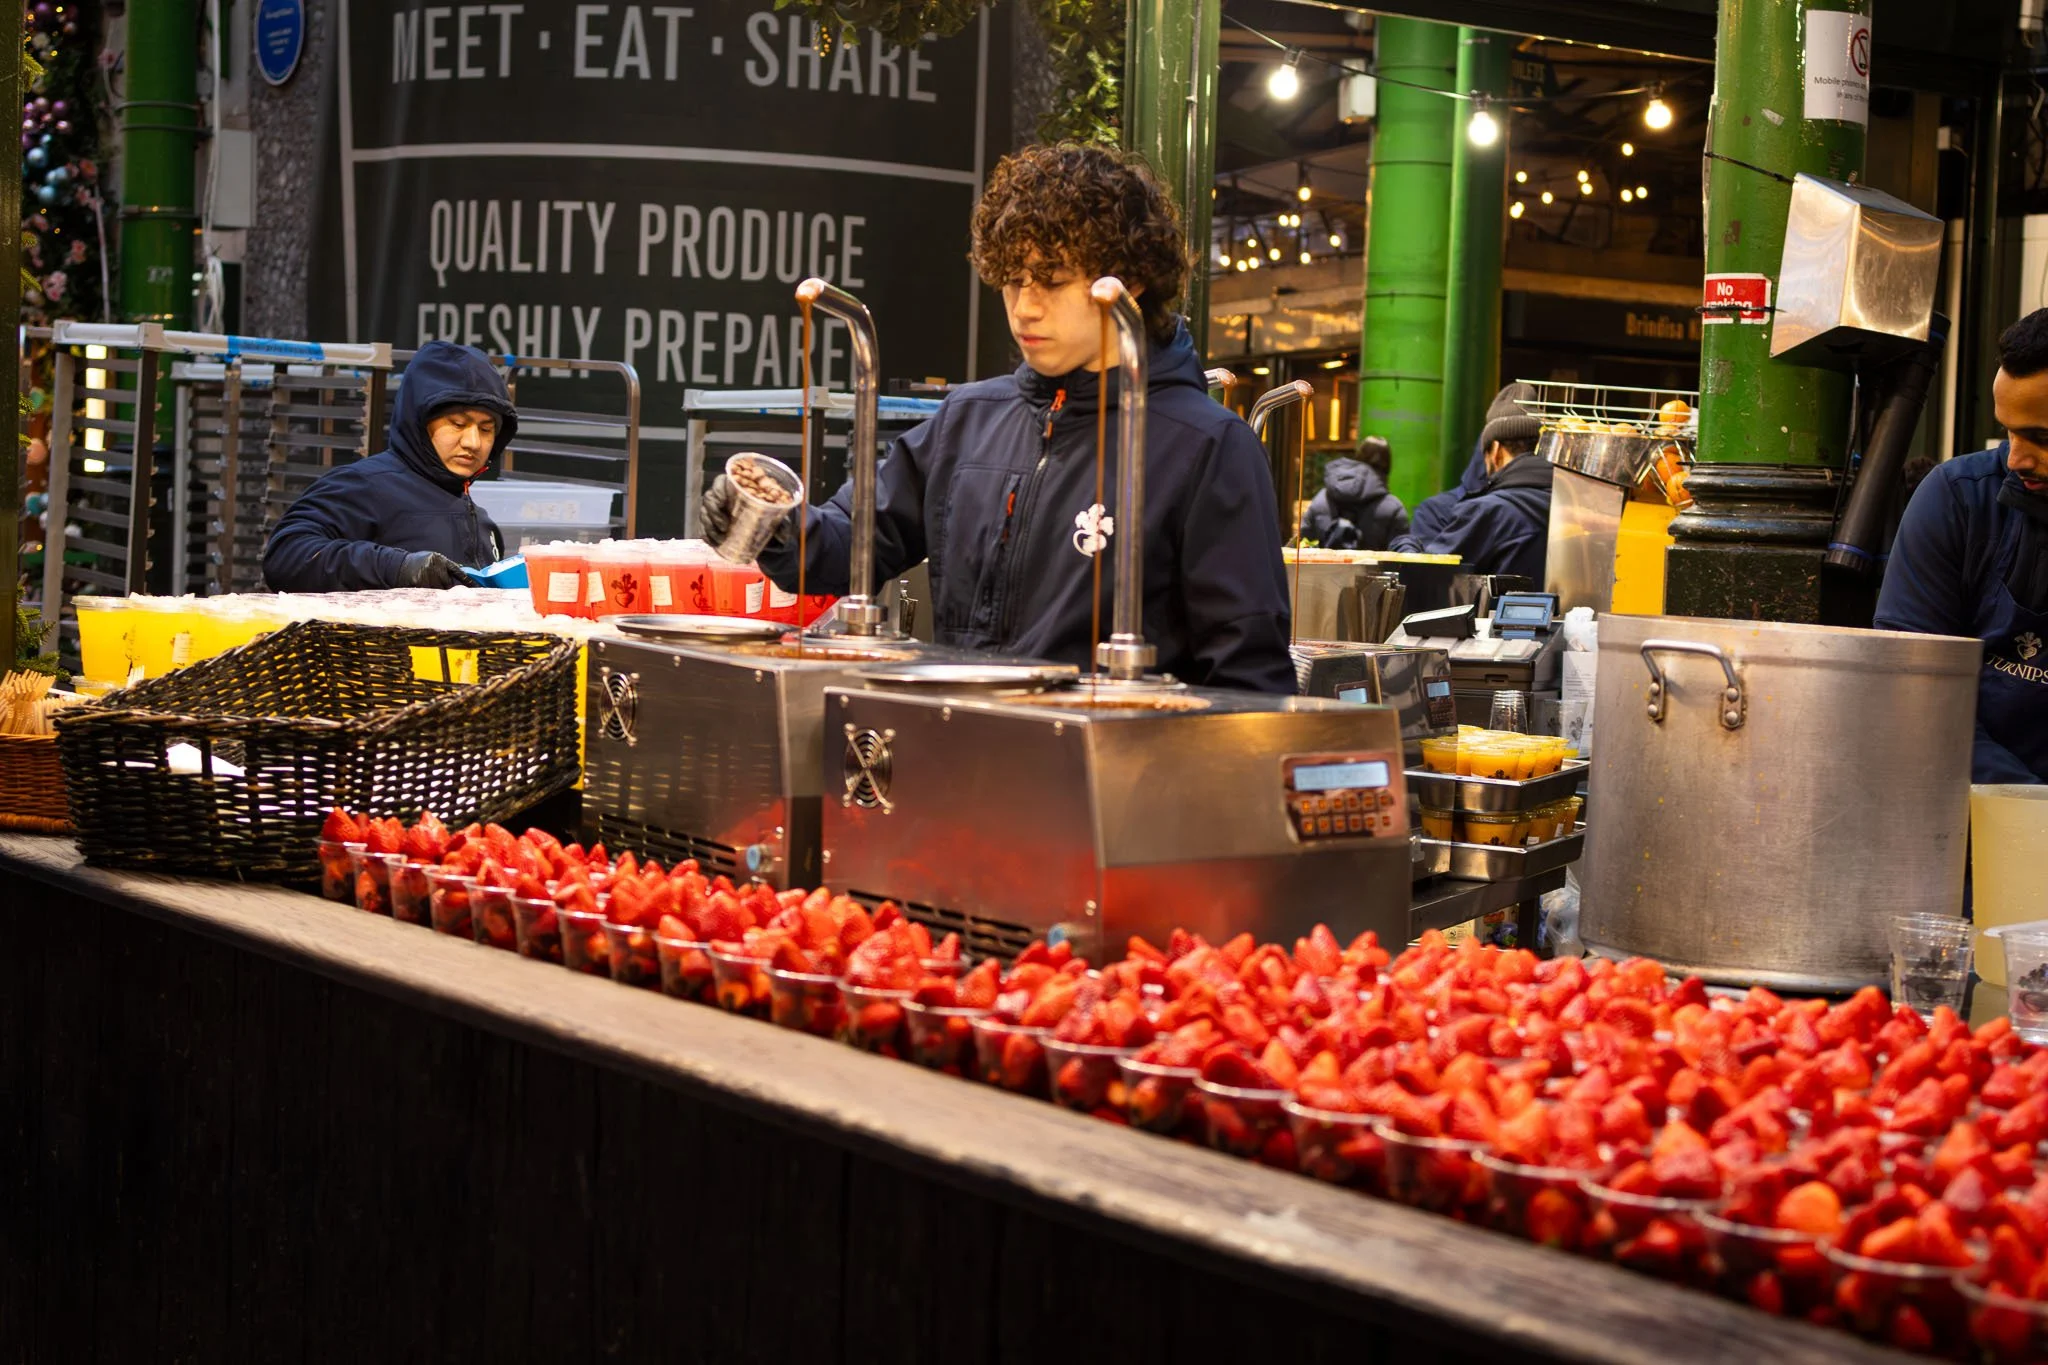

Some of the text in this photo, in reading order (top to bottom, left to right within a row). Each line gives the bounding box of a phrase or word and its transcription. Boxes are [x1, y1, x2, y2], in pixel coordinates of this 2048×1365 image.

[392, 4, 938, 103] MEET EAT SHARE
[1814, 76, 1840, 86] Mobile
[430, 199, 866, 288] QUALITY PRODUCE
[1716, 281, 1734, 297] No
[418, 302, 858, 391] FRESHLY PREPARE
[1985, 652, 2048, 685] TURNIPS
